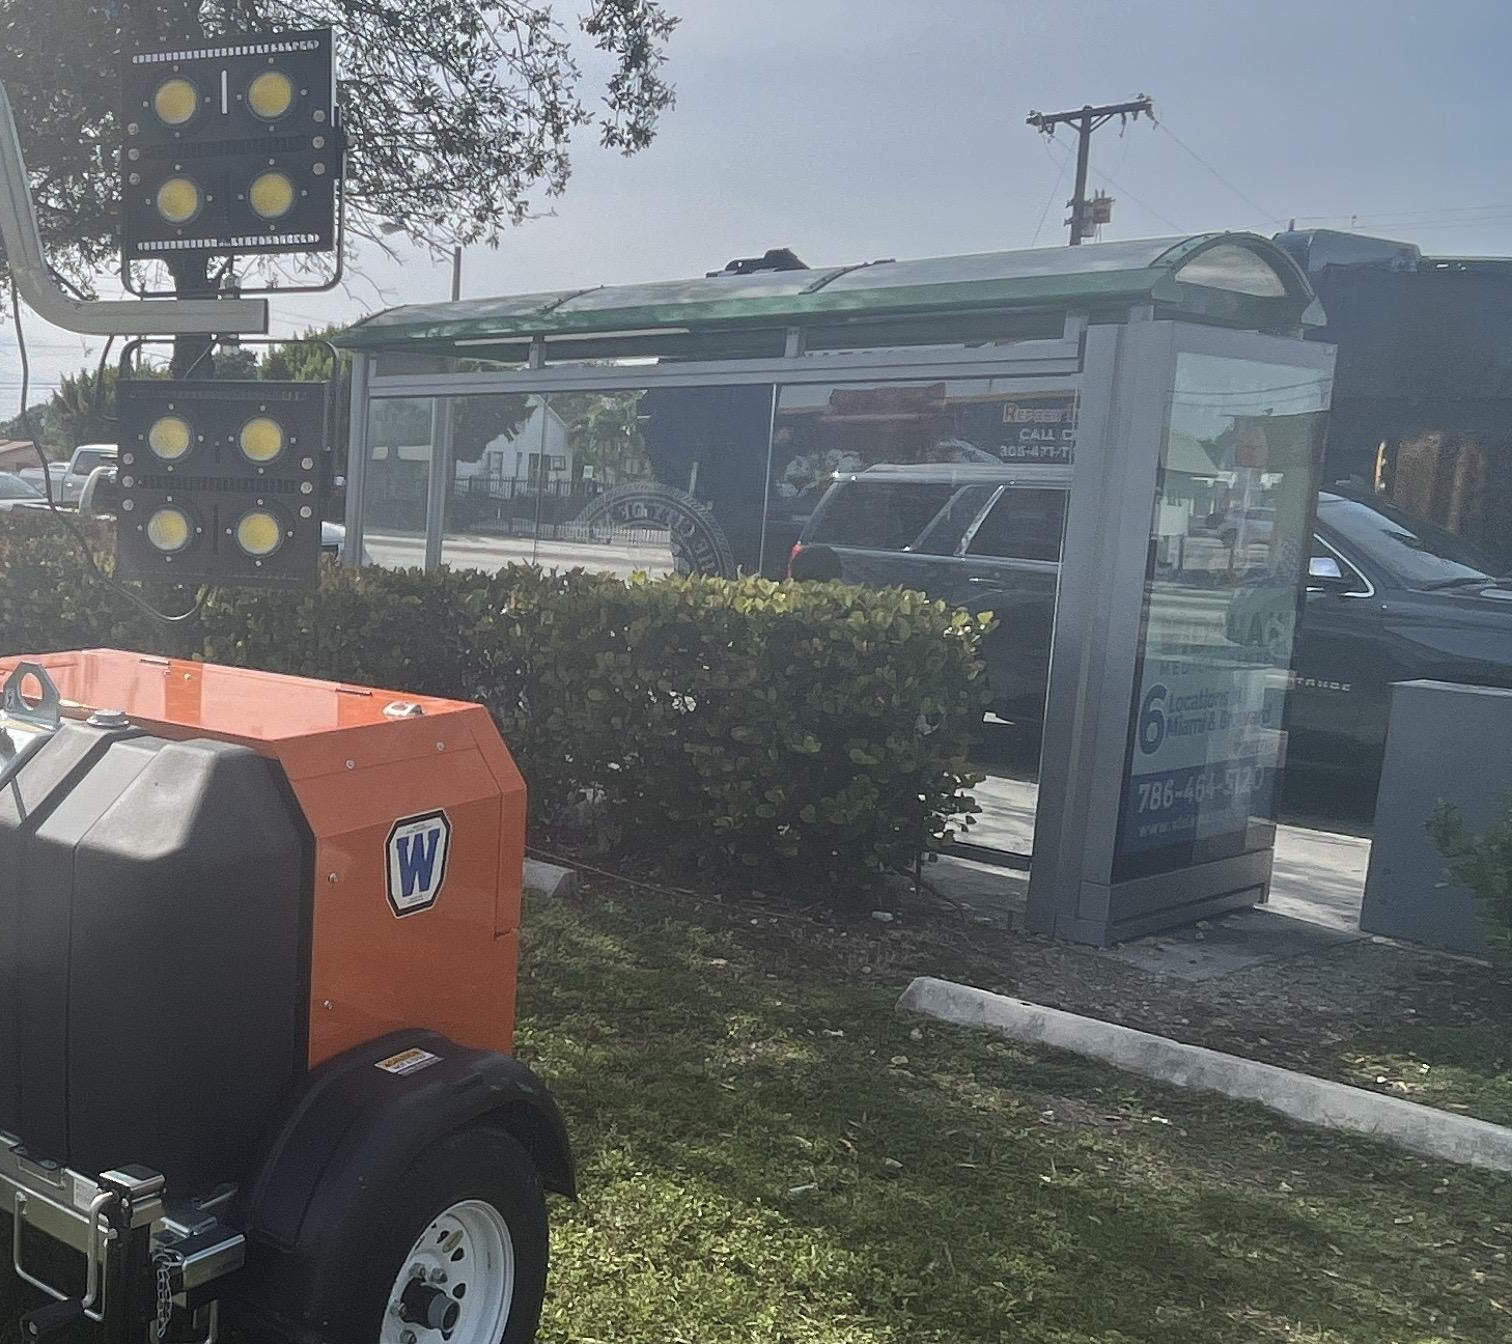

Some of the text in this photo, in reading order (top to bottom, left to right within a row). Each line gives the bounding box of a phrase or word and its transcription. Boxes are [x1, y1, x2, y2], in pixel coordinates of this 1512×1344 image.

[1019, 428, 1056, 441] CALL
[1140, 684, 1169, 755] 6
[396, 828, 441, 898] W
